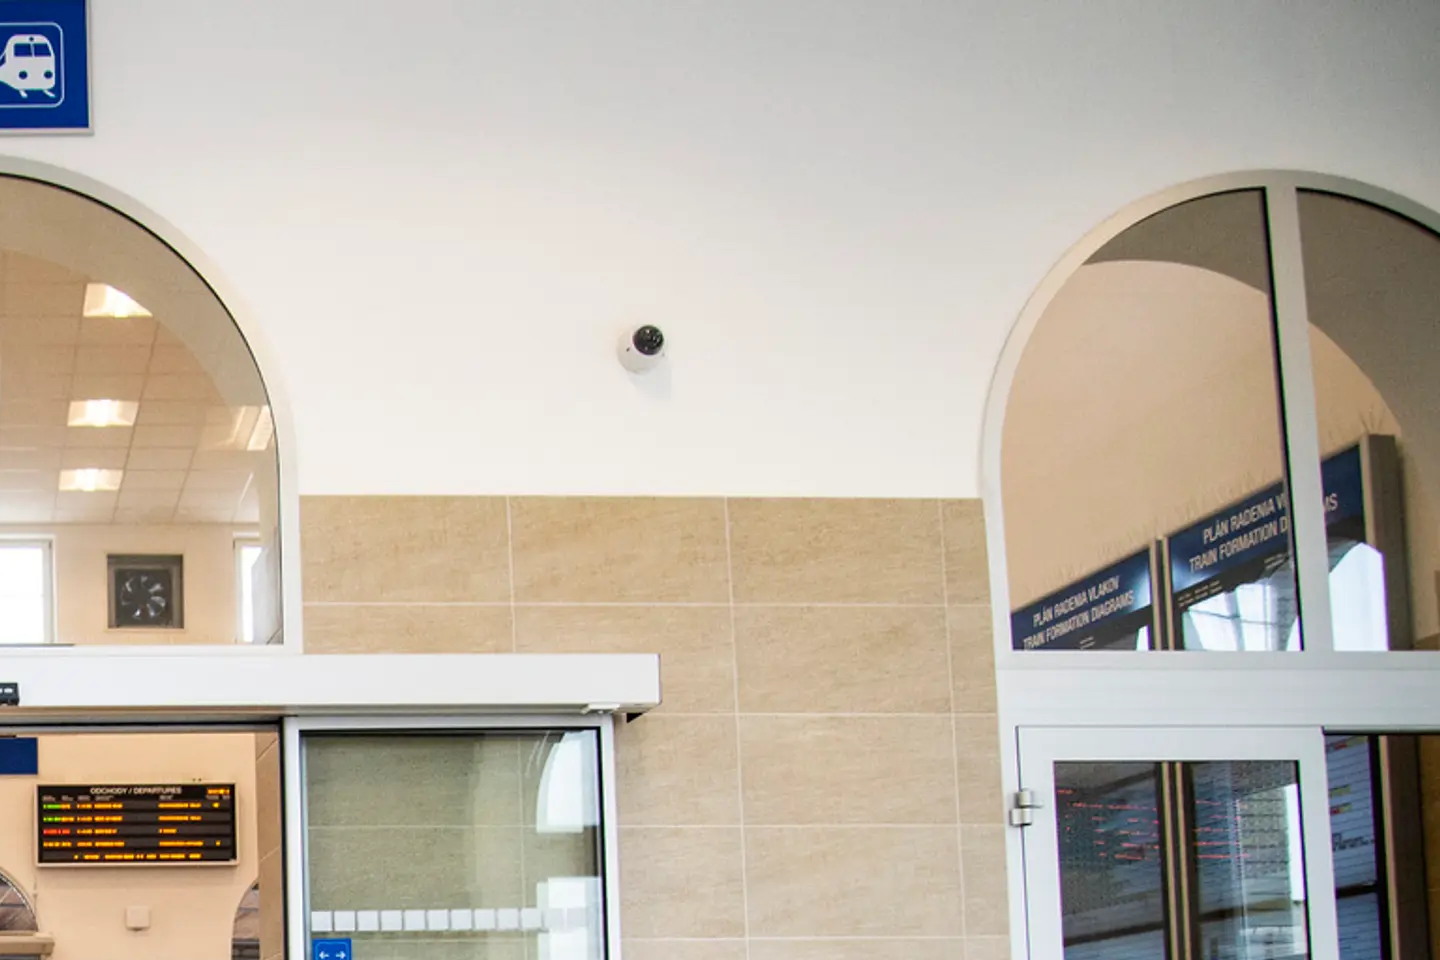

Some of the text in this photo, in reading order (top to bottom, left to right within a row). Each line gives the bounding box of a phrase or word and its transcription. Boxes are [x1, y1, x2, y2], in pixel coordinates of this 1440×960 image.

[1189, 543, 1218, 573] TRAIN
[1219, 520, 1278, 558] FORMATION
[1202, 517, 1229, 545] PLÁN
[1023, 632, 1045, 650] TRAIN
[1046, 610, 1090, 642] FORMATION
[1091, 589, 1135, 622] DIAGRAMS
[133, 786, 182, 795] DEPARTURES
